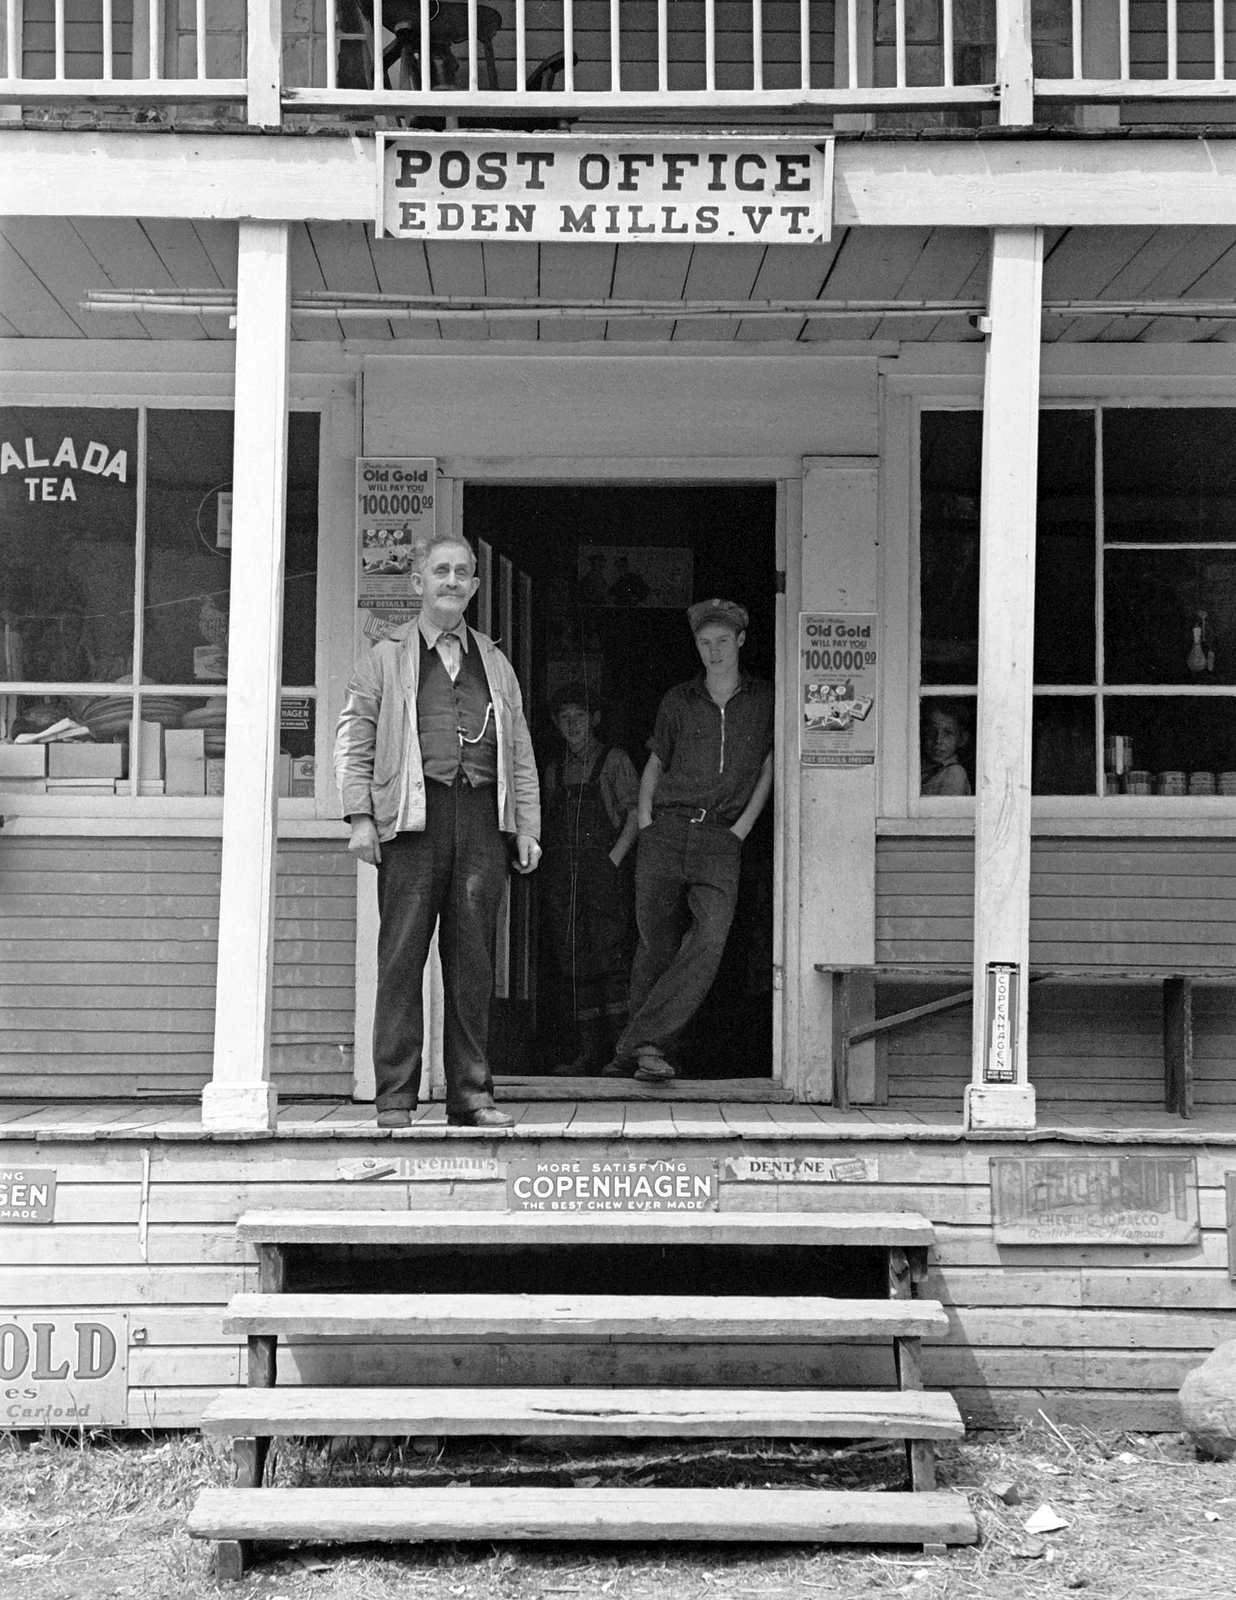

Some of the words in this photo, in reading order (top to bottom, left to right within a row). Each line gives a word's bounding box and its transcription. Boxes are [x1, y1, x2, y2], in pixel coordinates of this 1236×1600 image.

[395, 149, 555, 191] POST
[578, 153, 811, 192] OFFICE
[398, 202, 537, 232] EDEN
[0, 437, 128, 483] ALADA
[363, 470, 389, 482] Old
[392, 470, 428, 482] Gold
[24, 478, 77, 501] TEA
[368, 484, 388, 492] WILL
[390, 484, 405, 492] PAY
[407, 484, 424, 493] YOU
[360, 600, 374, 608] GET
[376, 600, 405, 608] DETAILS
[407, 600, 422, 608] INS
[806, 624, 832, 637] Old
[835, 625, 871, 638] Gold
[811, 639, 831, 648] WILL
[833, 639, 847, 648] PAY
[850, 639, 867, 649] YOU
[802, 756, 816, 764] GET
[817, 756, 846, 764] DETAILS
[996, 975, 1007, 1068] COPENHAGEN
[537, 1163, 581, 1173] MORE
[592, 1162, 687, 1173] SATISFYING
[750, 1161, 825, 1173] DENTNE
[513, 1176, 711, 1199] COPENHAGEN
[522, 1201, 546, 1210] THE
[551, 1201, 584, 1210] BEST
[587, 1201, 623, 1210] CHEW
[627, 1201, 661, 1210] EVER
[667, 1201, 704, 1210] MADE
[1, 1210, 38, 1219] MADE
[1101, 1213, 1159, 1227] TOBACCO
[1121, 1228, 1166, 1240] famous
[0, 1322, 117, 1381] OLD
[5, 1388, 38, 1400] es
[6, 1404, 91, 1418] Carload
